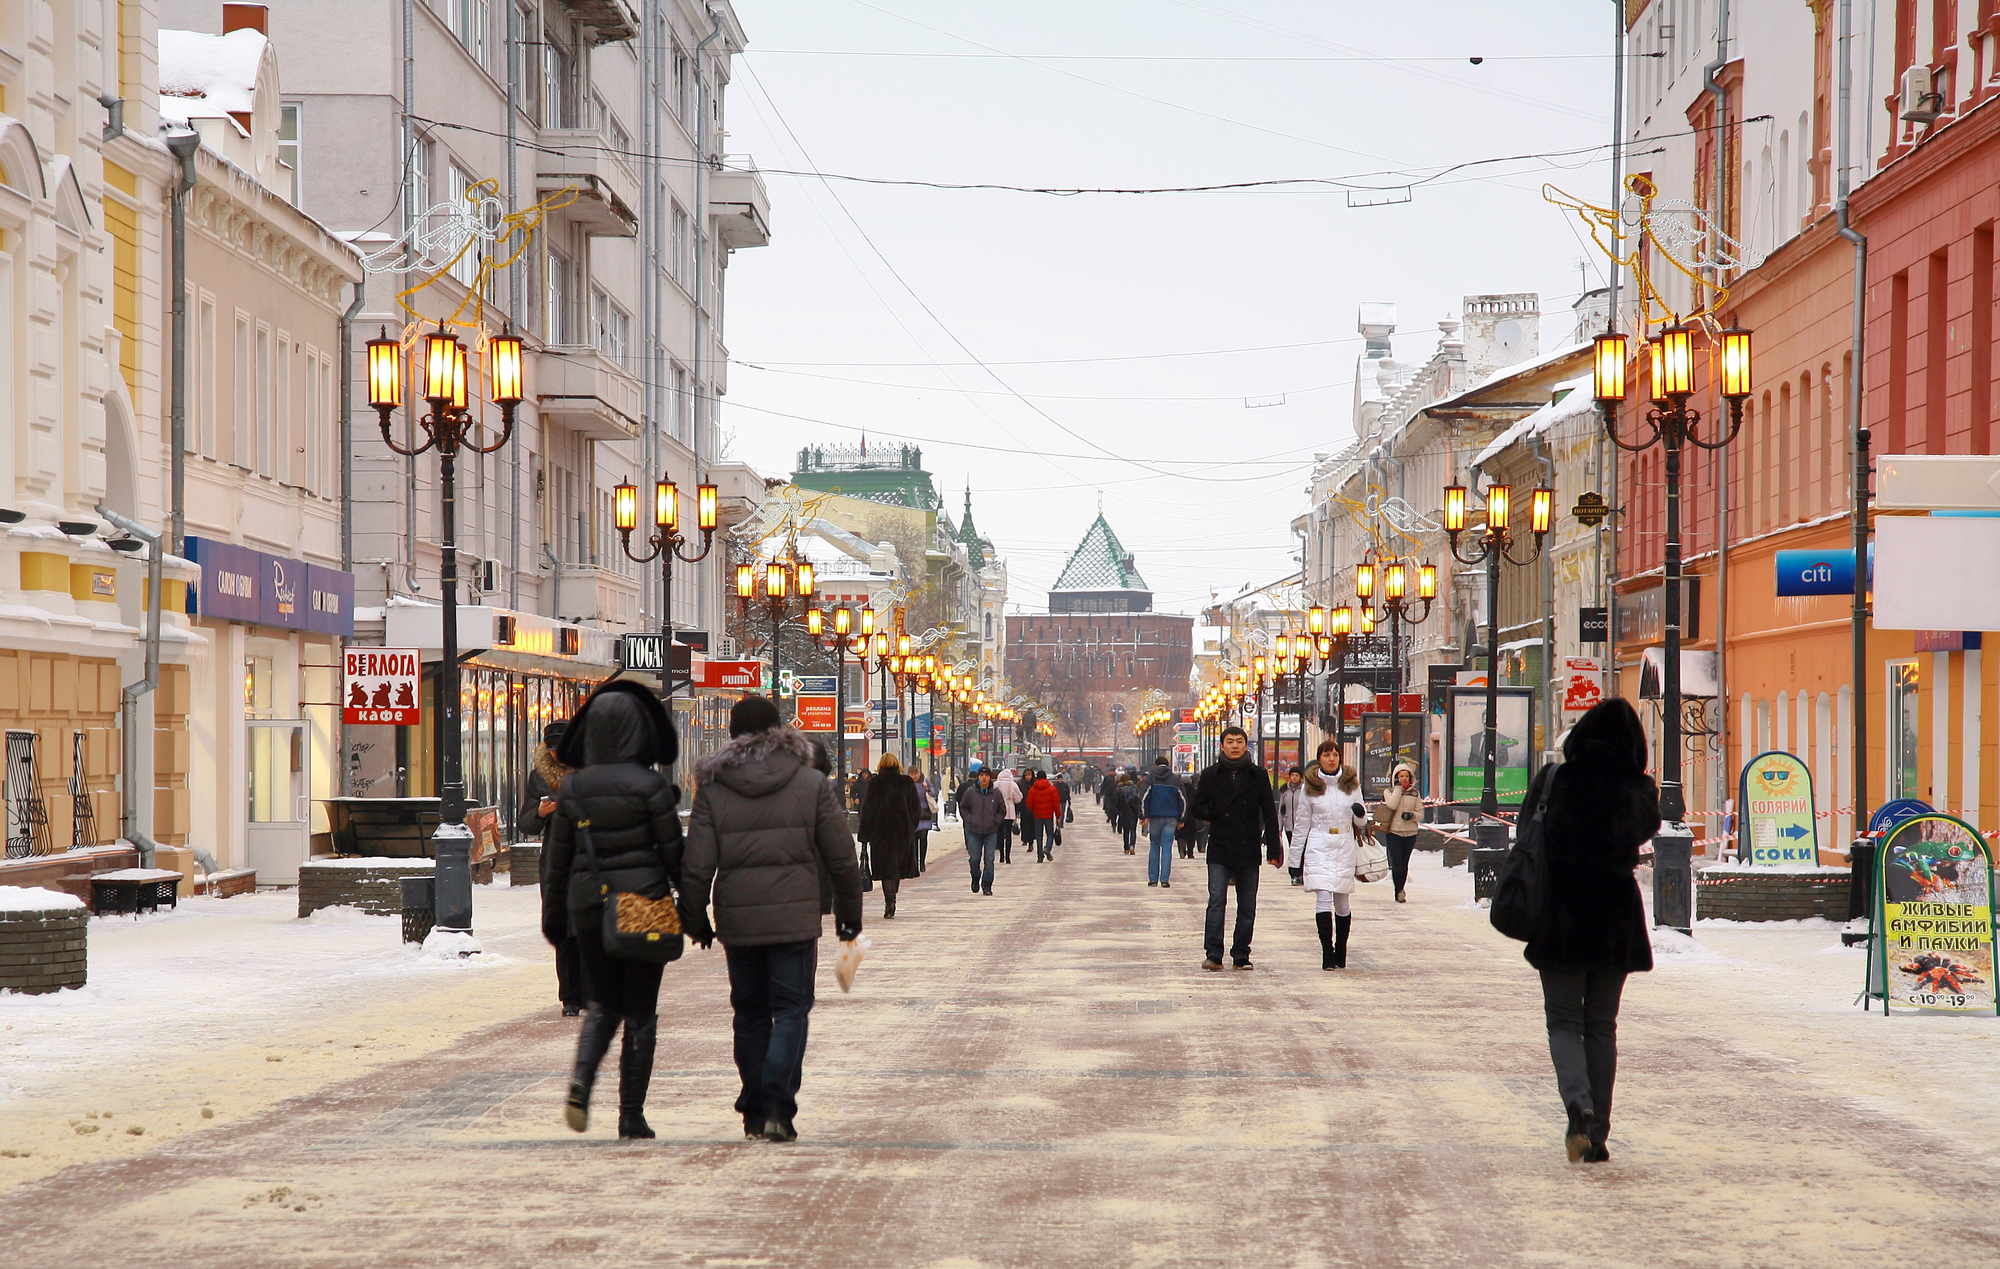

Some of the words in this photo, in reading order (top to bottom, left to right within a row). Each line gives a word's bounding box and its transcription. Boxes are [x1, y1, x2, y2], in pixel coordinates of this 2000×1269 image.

[1801, 565, 1832, 582] citi
[312, 589, 326, 612] САЛН
[722, 675, 749, 685] PUMA
[1751, 797, 1808, 814] СОЛЯРИЙ
[1755, 848, 1811, 860] СОКИ
[1901, 902, 1974, 917] ЖИВЫЕ
[1891, 919, 1987, 934] АМФИБИИ
[1900, 935, 1912, 949] И
[1918, 936, 1980, 951] ПАУКИ
